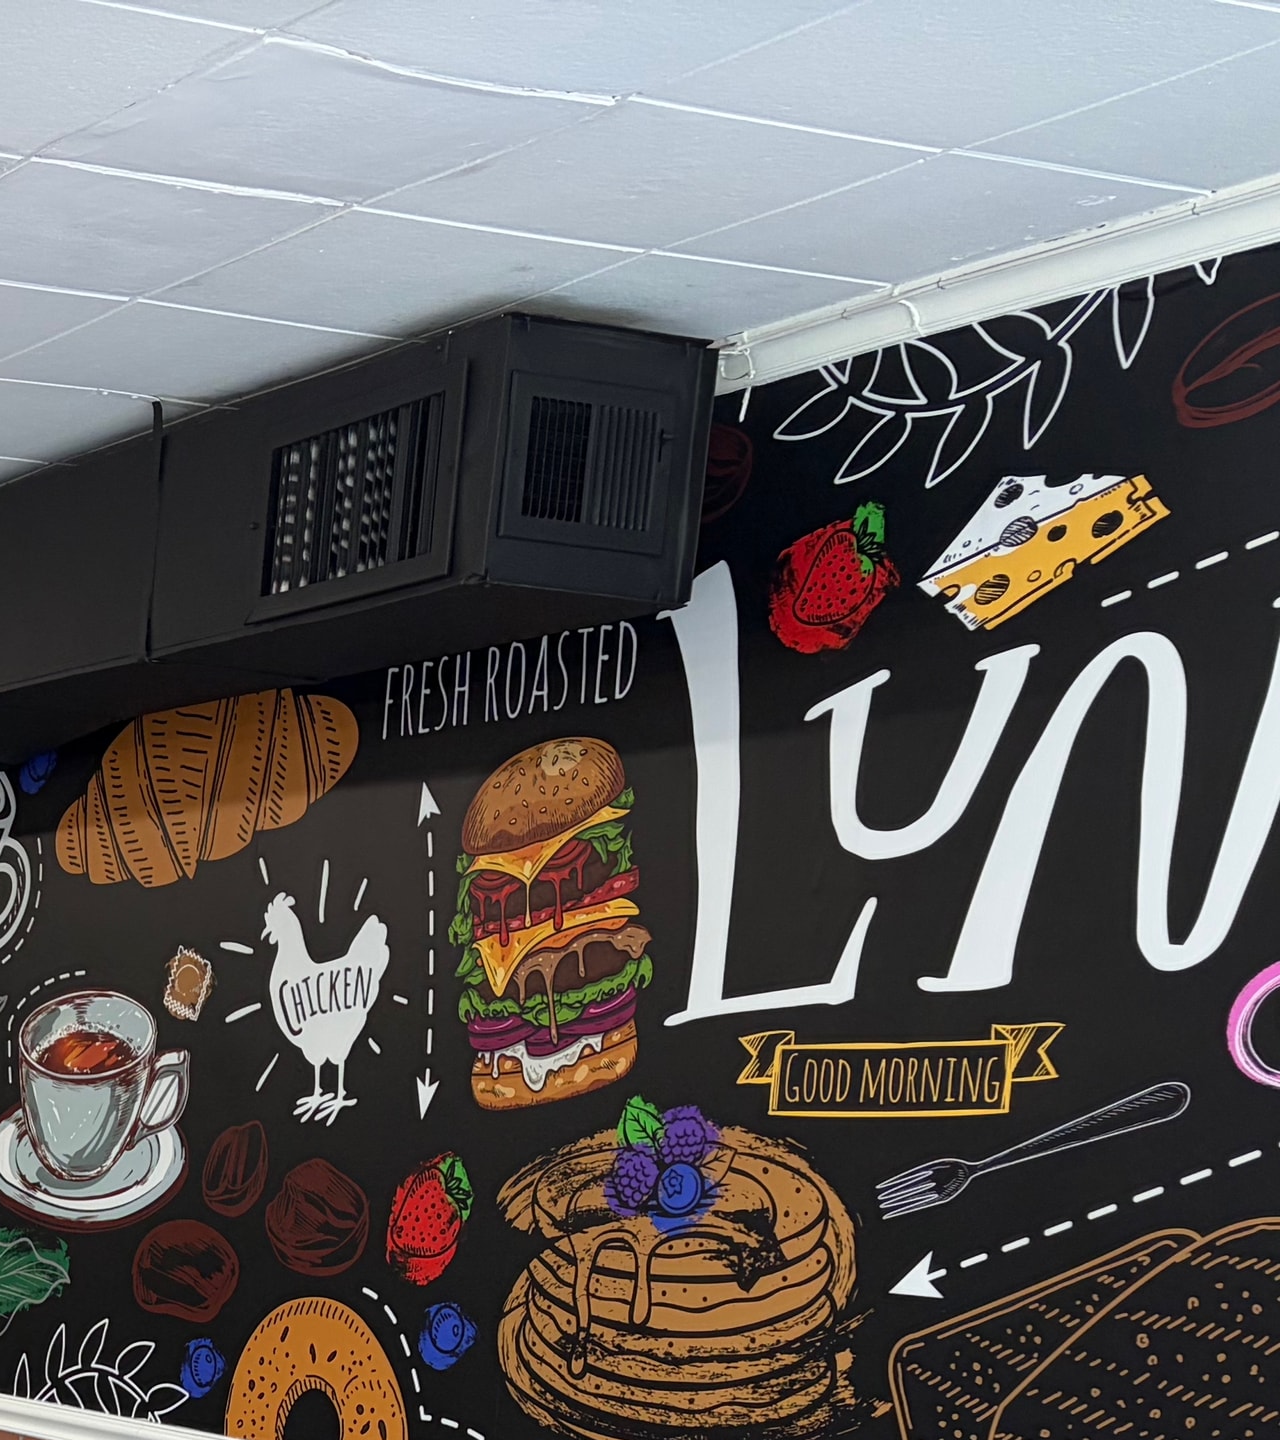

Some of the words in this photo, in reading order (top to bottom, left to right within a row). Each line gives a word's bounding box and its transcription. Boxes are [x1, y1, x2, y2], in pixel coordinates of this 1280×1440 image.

[382, 651, 471, 740] FRESH
[484, 620, 638, 723] ROASTED
[279, 965, 372, 1037] CHICKEN
[785, 1053, 851, 1103] GOOD
[859, 1057, 1000, 1105] MORNING
